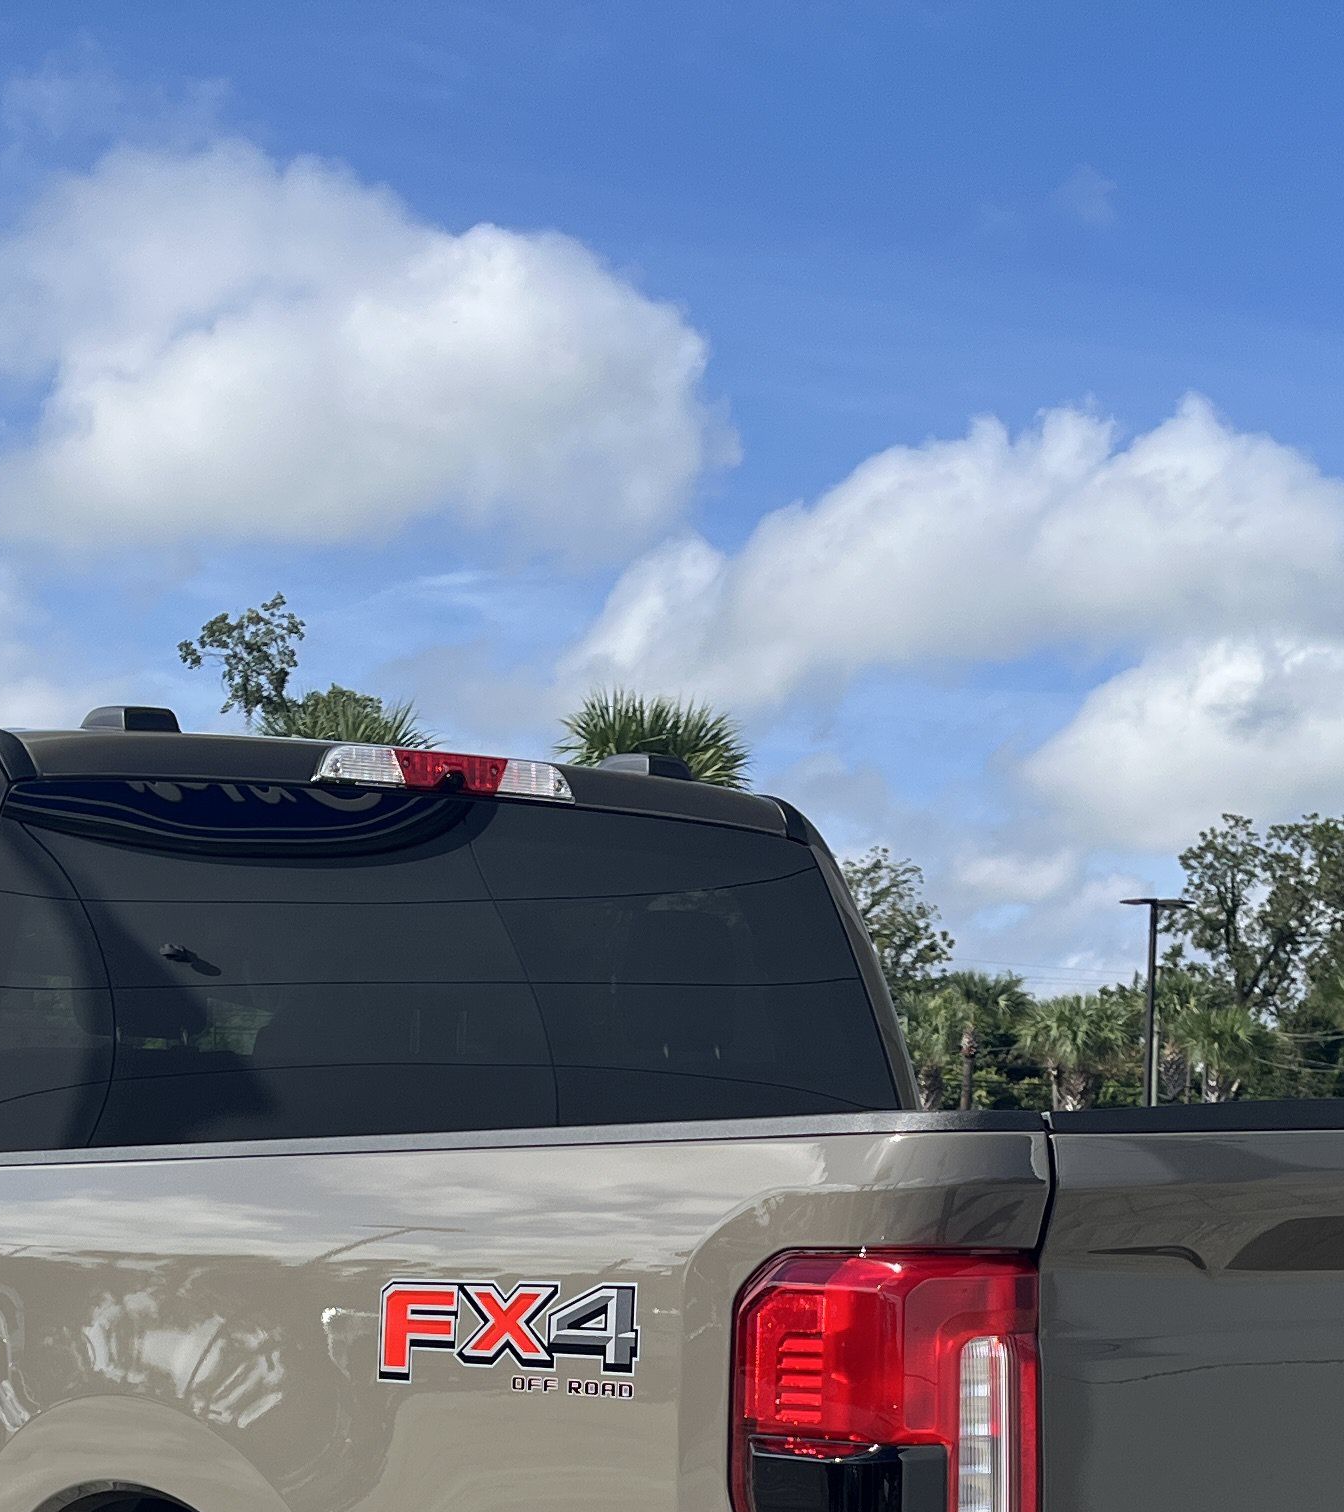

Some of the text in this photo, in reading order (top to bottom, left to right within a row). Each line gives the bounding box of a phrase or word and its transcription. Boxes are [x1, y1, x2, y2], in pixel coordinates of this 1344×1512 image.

[377, 1278, 640, 1383] FX4
[511, 1375, 635, 1400] OFF ROAD
